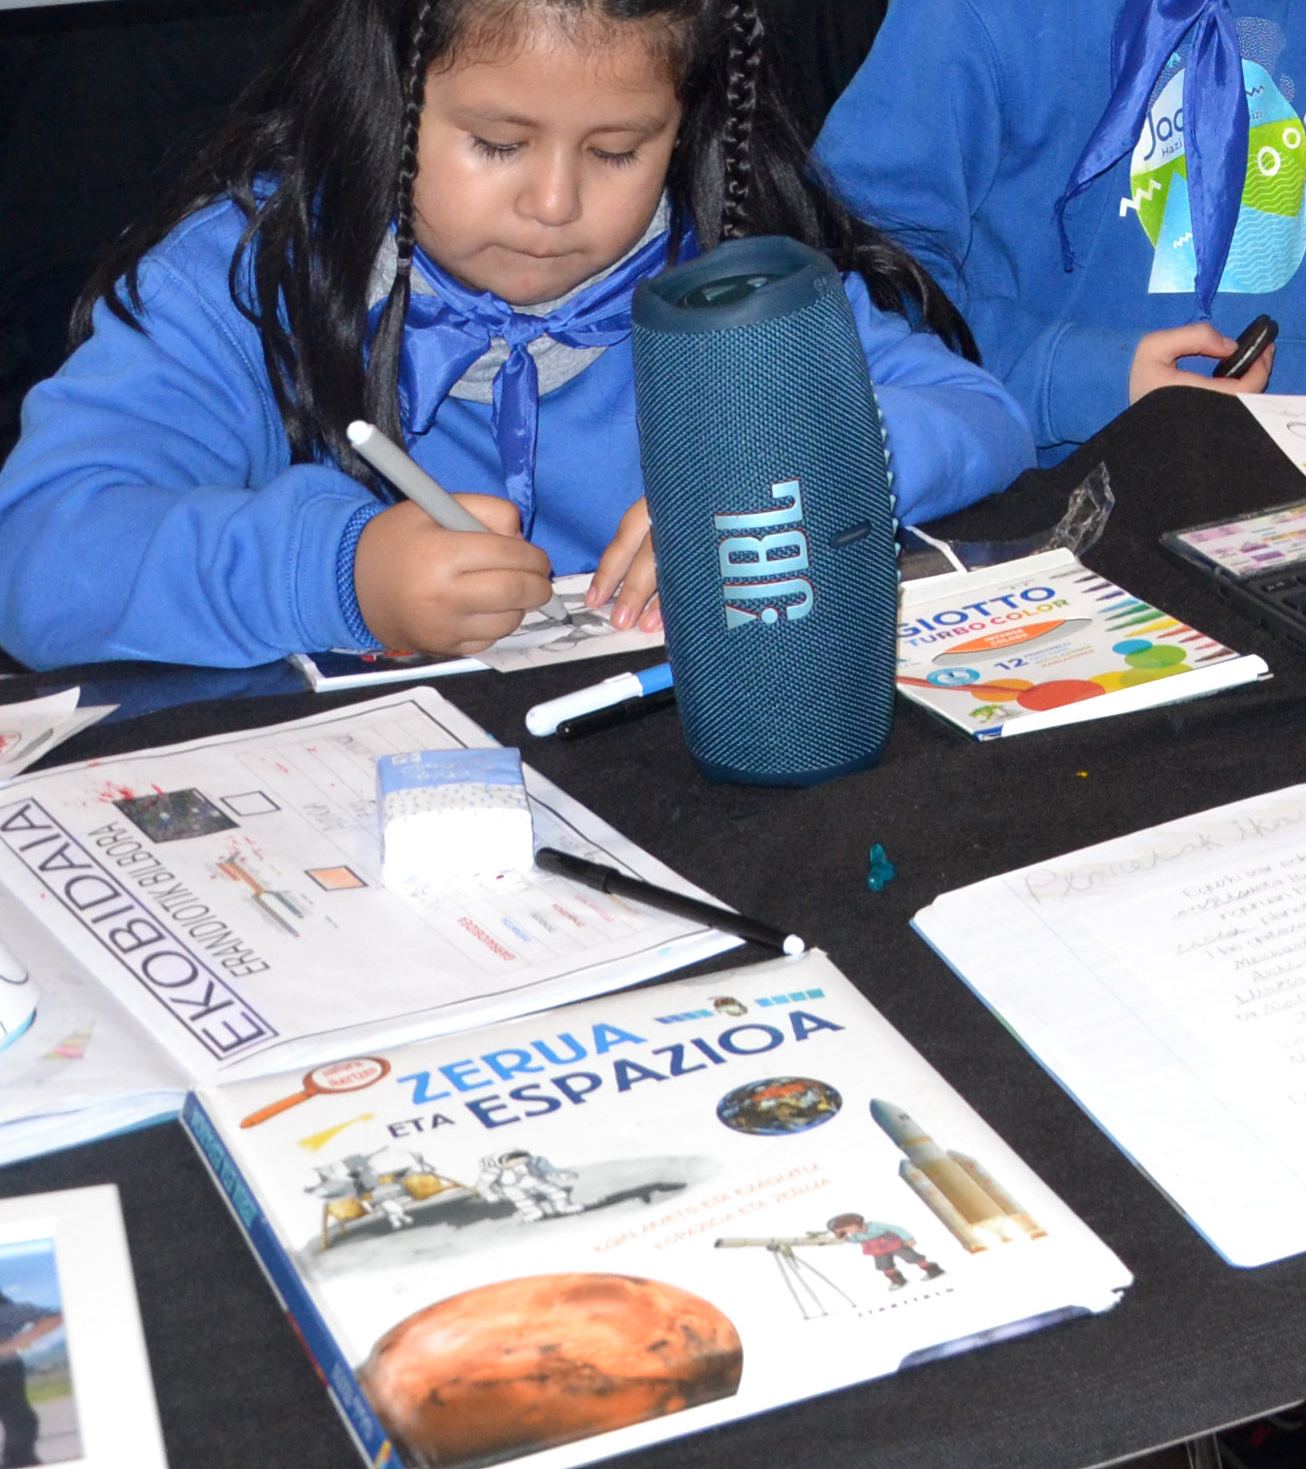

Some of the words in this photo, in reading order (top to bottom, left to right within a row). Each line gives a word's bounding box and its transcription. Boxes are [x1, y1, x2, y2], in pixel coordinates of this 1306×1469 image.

[714, 479, 814, 624] JBL
[897, 585, 1057, 639] GIOTTO
[903, 621, 987, 648] TURBO
[989, 597, 1072, 626] COLOR
[993, 656, 1031, 672] 12
[87, 820, 176, 888] BILBORA
[1, 802, 267, 1055] EKOBIDAIA
[147, 881, 271, 978] ERANDIOTIK
[387, 1111, 457, 1142] ETA
[462, 1009, 845, 1130] ESPAZIOA
[396, 1021, 648, 1107] ZERUA
